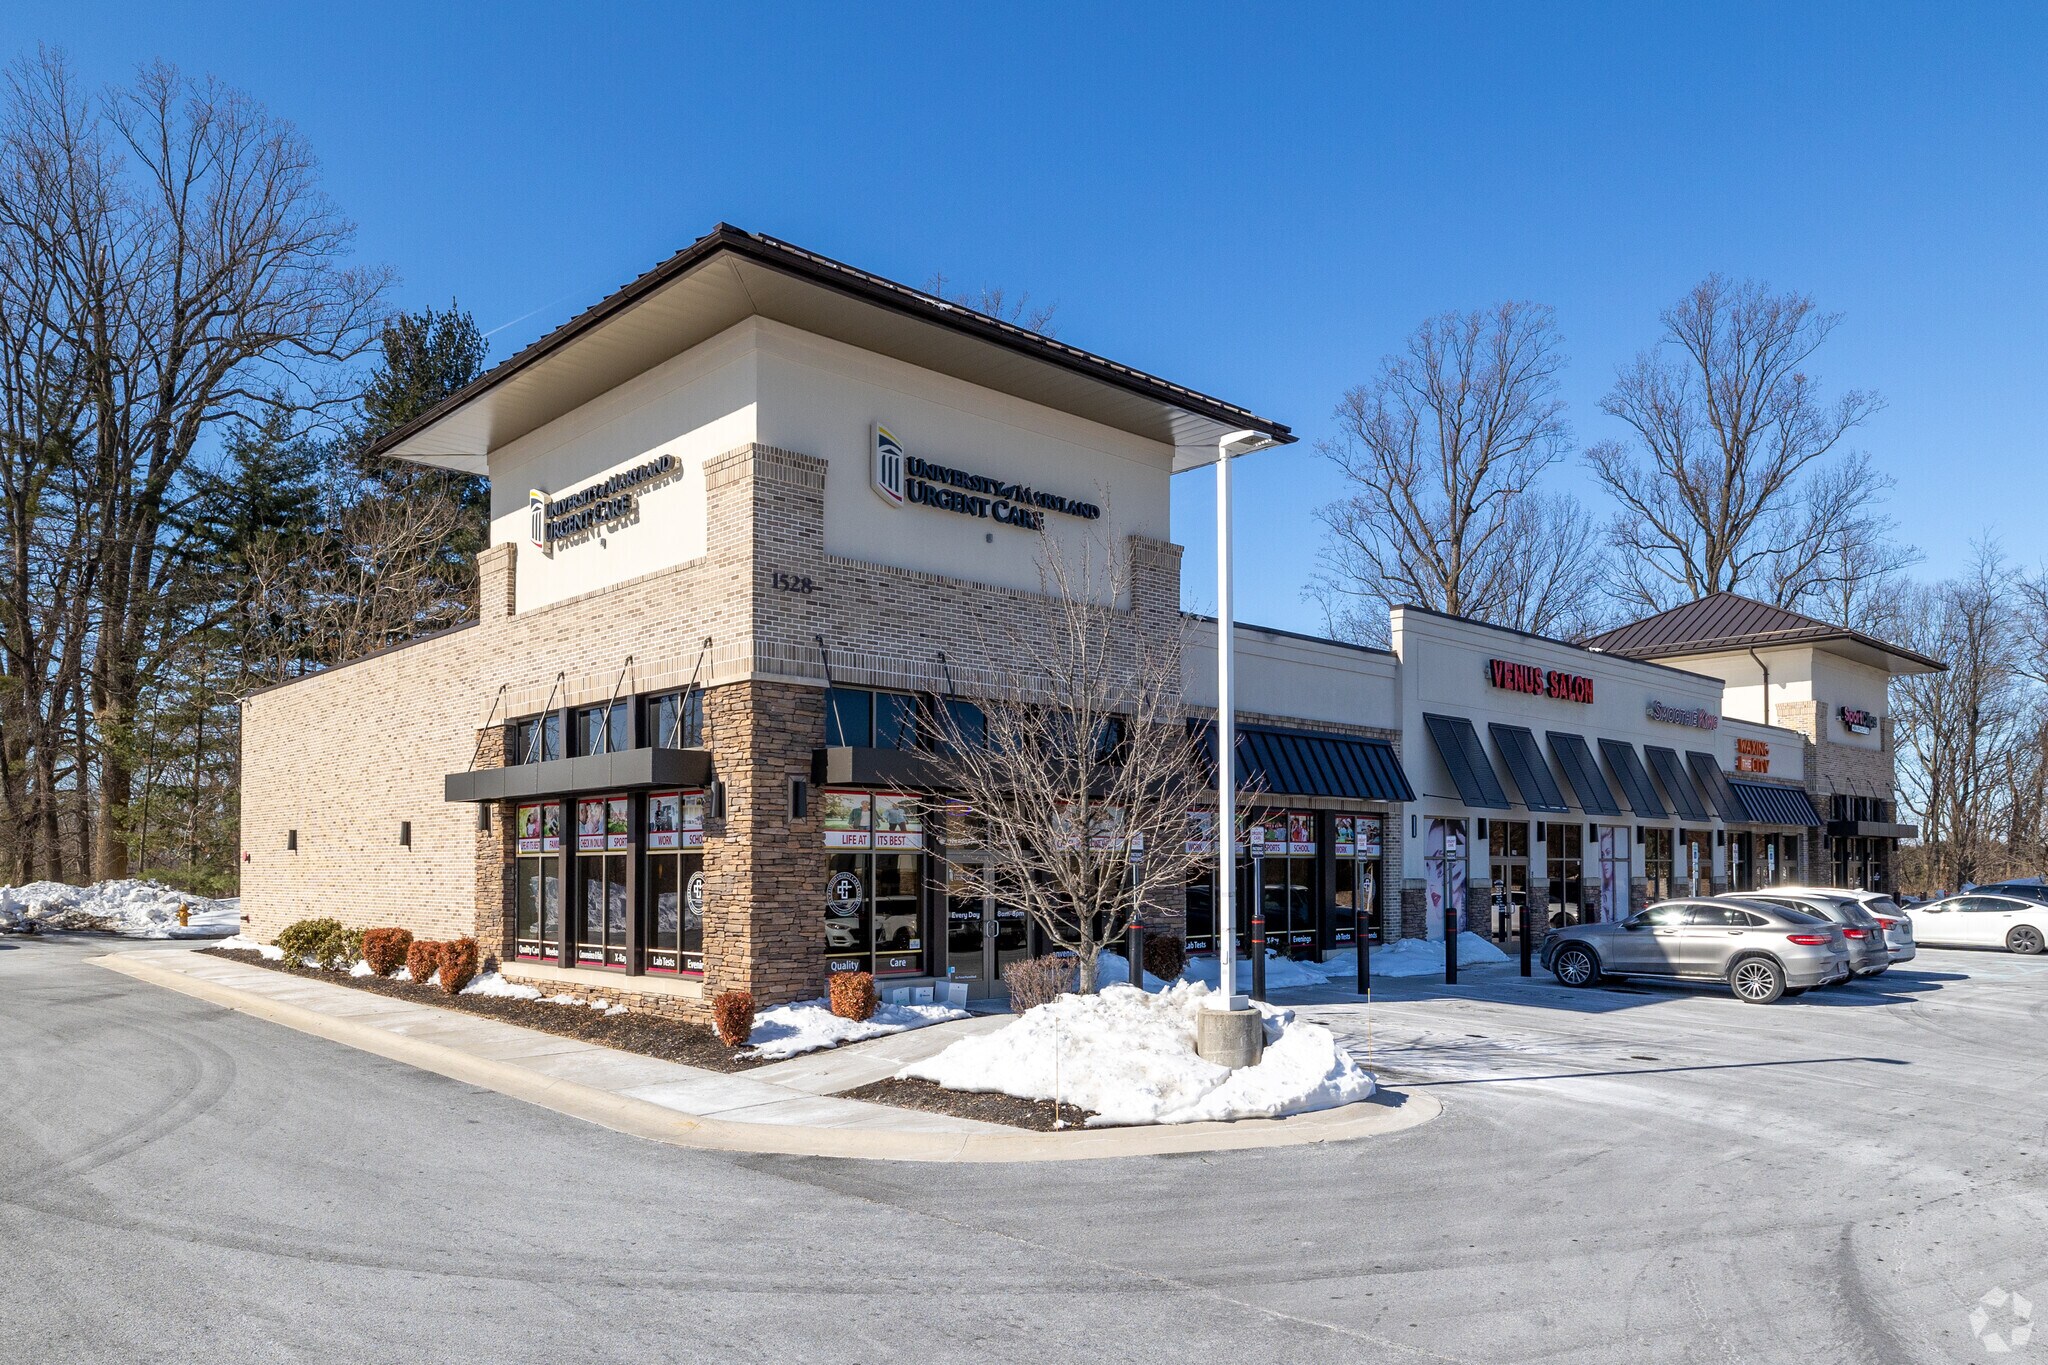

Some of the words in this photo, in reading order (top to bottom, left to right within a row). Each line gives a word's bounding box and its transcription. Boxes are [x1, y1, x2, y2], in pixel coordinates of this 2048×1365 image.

[545, 484, 601, 519] UNIVERSITY
[608, 454, 675, 493] MARYLAND
[906, 456, 1005, 496] UNIVERSITY
[1002, 485, 1016, 499] of
[1014, 482, 1100, 519] MARYLAND
[906, 478, 990, 518] URGENT
[991, 500, 1045, 531] CARE
[544, 507, 593, 542] URGENT
[592, 494, 632, 523] CARE
[771, 572, 812, 594] 1528
[1490, 659, 1544, 696] VENUS
[1547, 670, 1594, 704] SALON
[1653, 700, 1698, 727] SMOOTHIE
[1737, 738, 1769, 756] WAXING
[1752, 758, 1769, 773] CITY
[614, 837, 627, 847] SPORT
[658, 836, 672, 845] WORK
[842, 834, 857, 844] LIFE
[858, 834, 867, 844] AT
[877, 835, 888, 845] ITS
[889, 836, 906, 846] BEST
[951, 911, 967, 919] Every
[968, 911, 980, 919] Day
[1194, 940, 1207, 949] Tests
[1293, 935, 1311, 943] Evenings
[653, 956, 662, 966] Lab
[662, 957, 675, 966] Tests
[831, 960, 859, 971] Quality
[890, 958, 907, 967] Care
